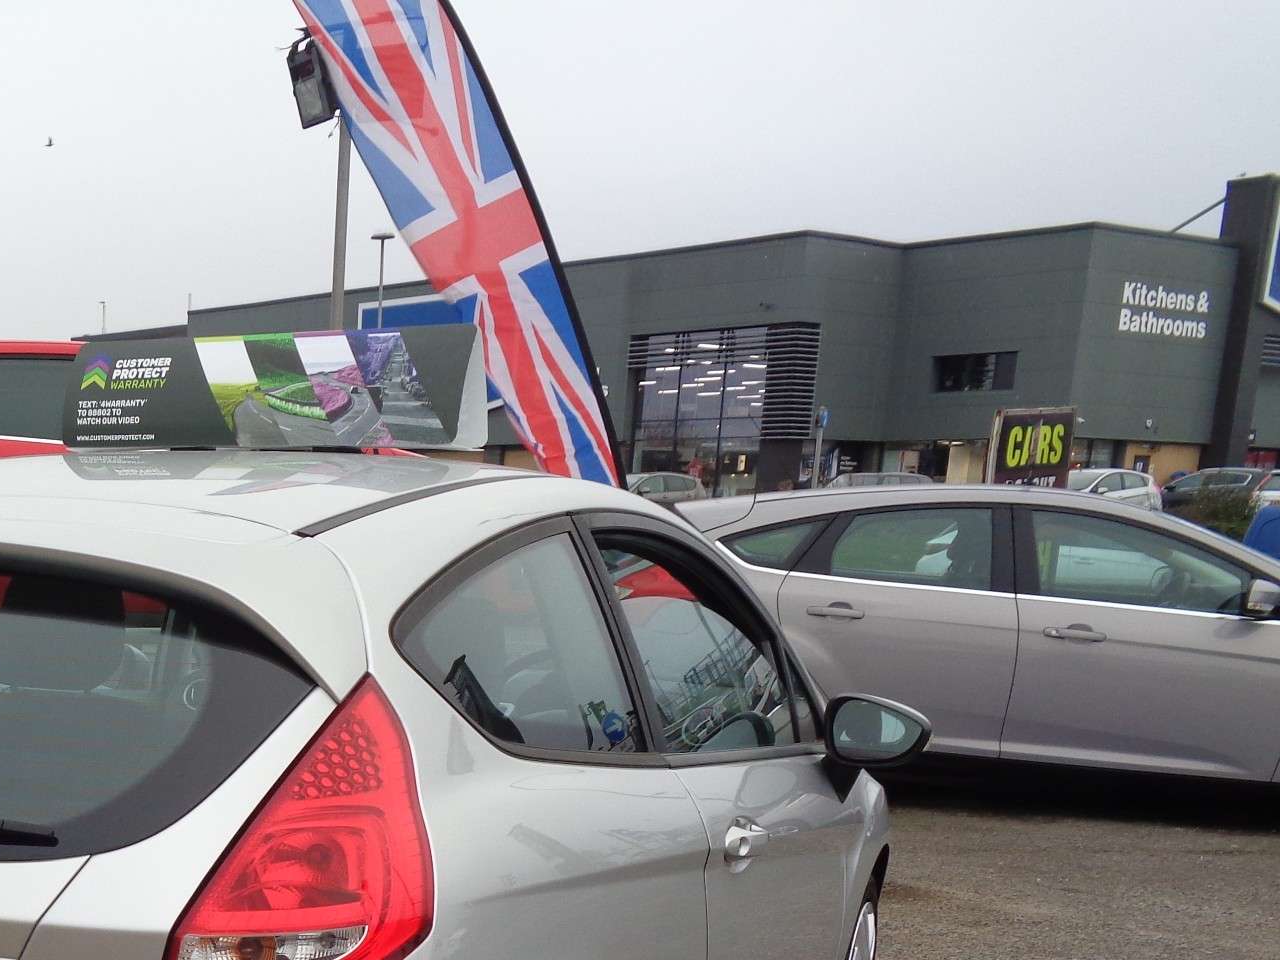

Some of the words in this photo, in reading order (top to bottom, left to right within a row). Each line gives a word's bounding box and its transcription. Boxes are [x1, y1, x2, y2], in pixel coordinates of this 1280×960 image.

[1122, 281, 1195, 311] Kitchens
[1197, 290, 1210, 312] &
[1118, 308, 1207, 338] Bathrooms
[115, 357, 172, 369] CUSTOMER
[111, 366, 170, 380] PROTECT
[110, 378, 167, 390] WARRANTY
[77, 409, 87, 417] TO
[112, 408, 122, 416] TO
[76, 416, 102, 425] WATCH
[102, 416, 117, 425] OUR
[118, 416, 140, 424] VIDEO
